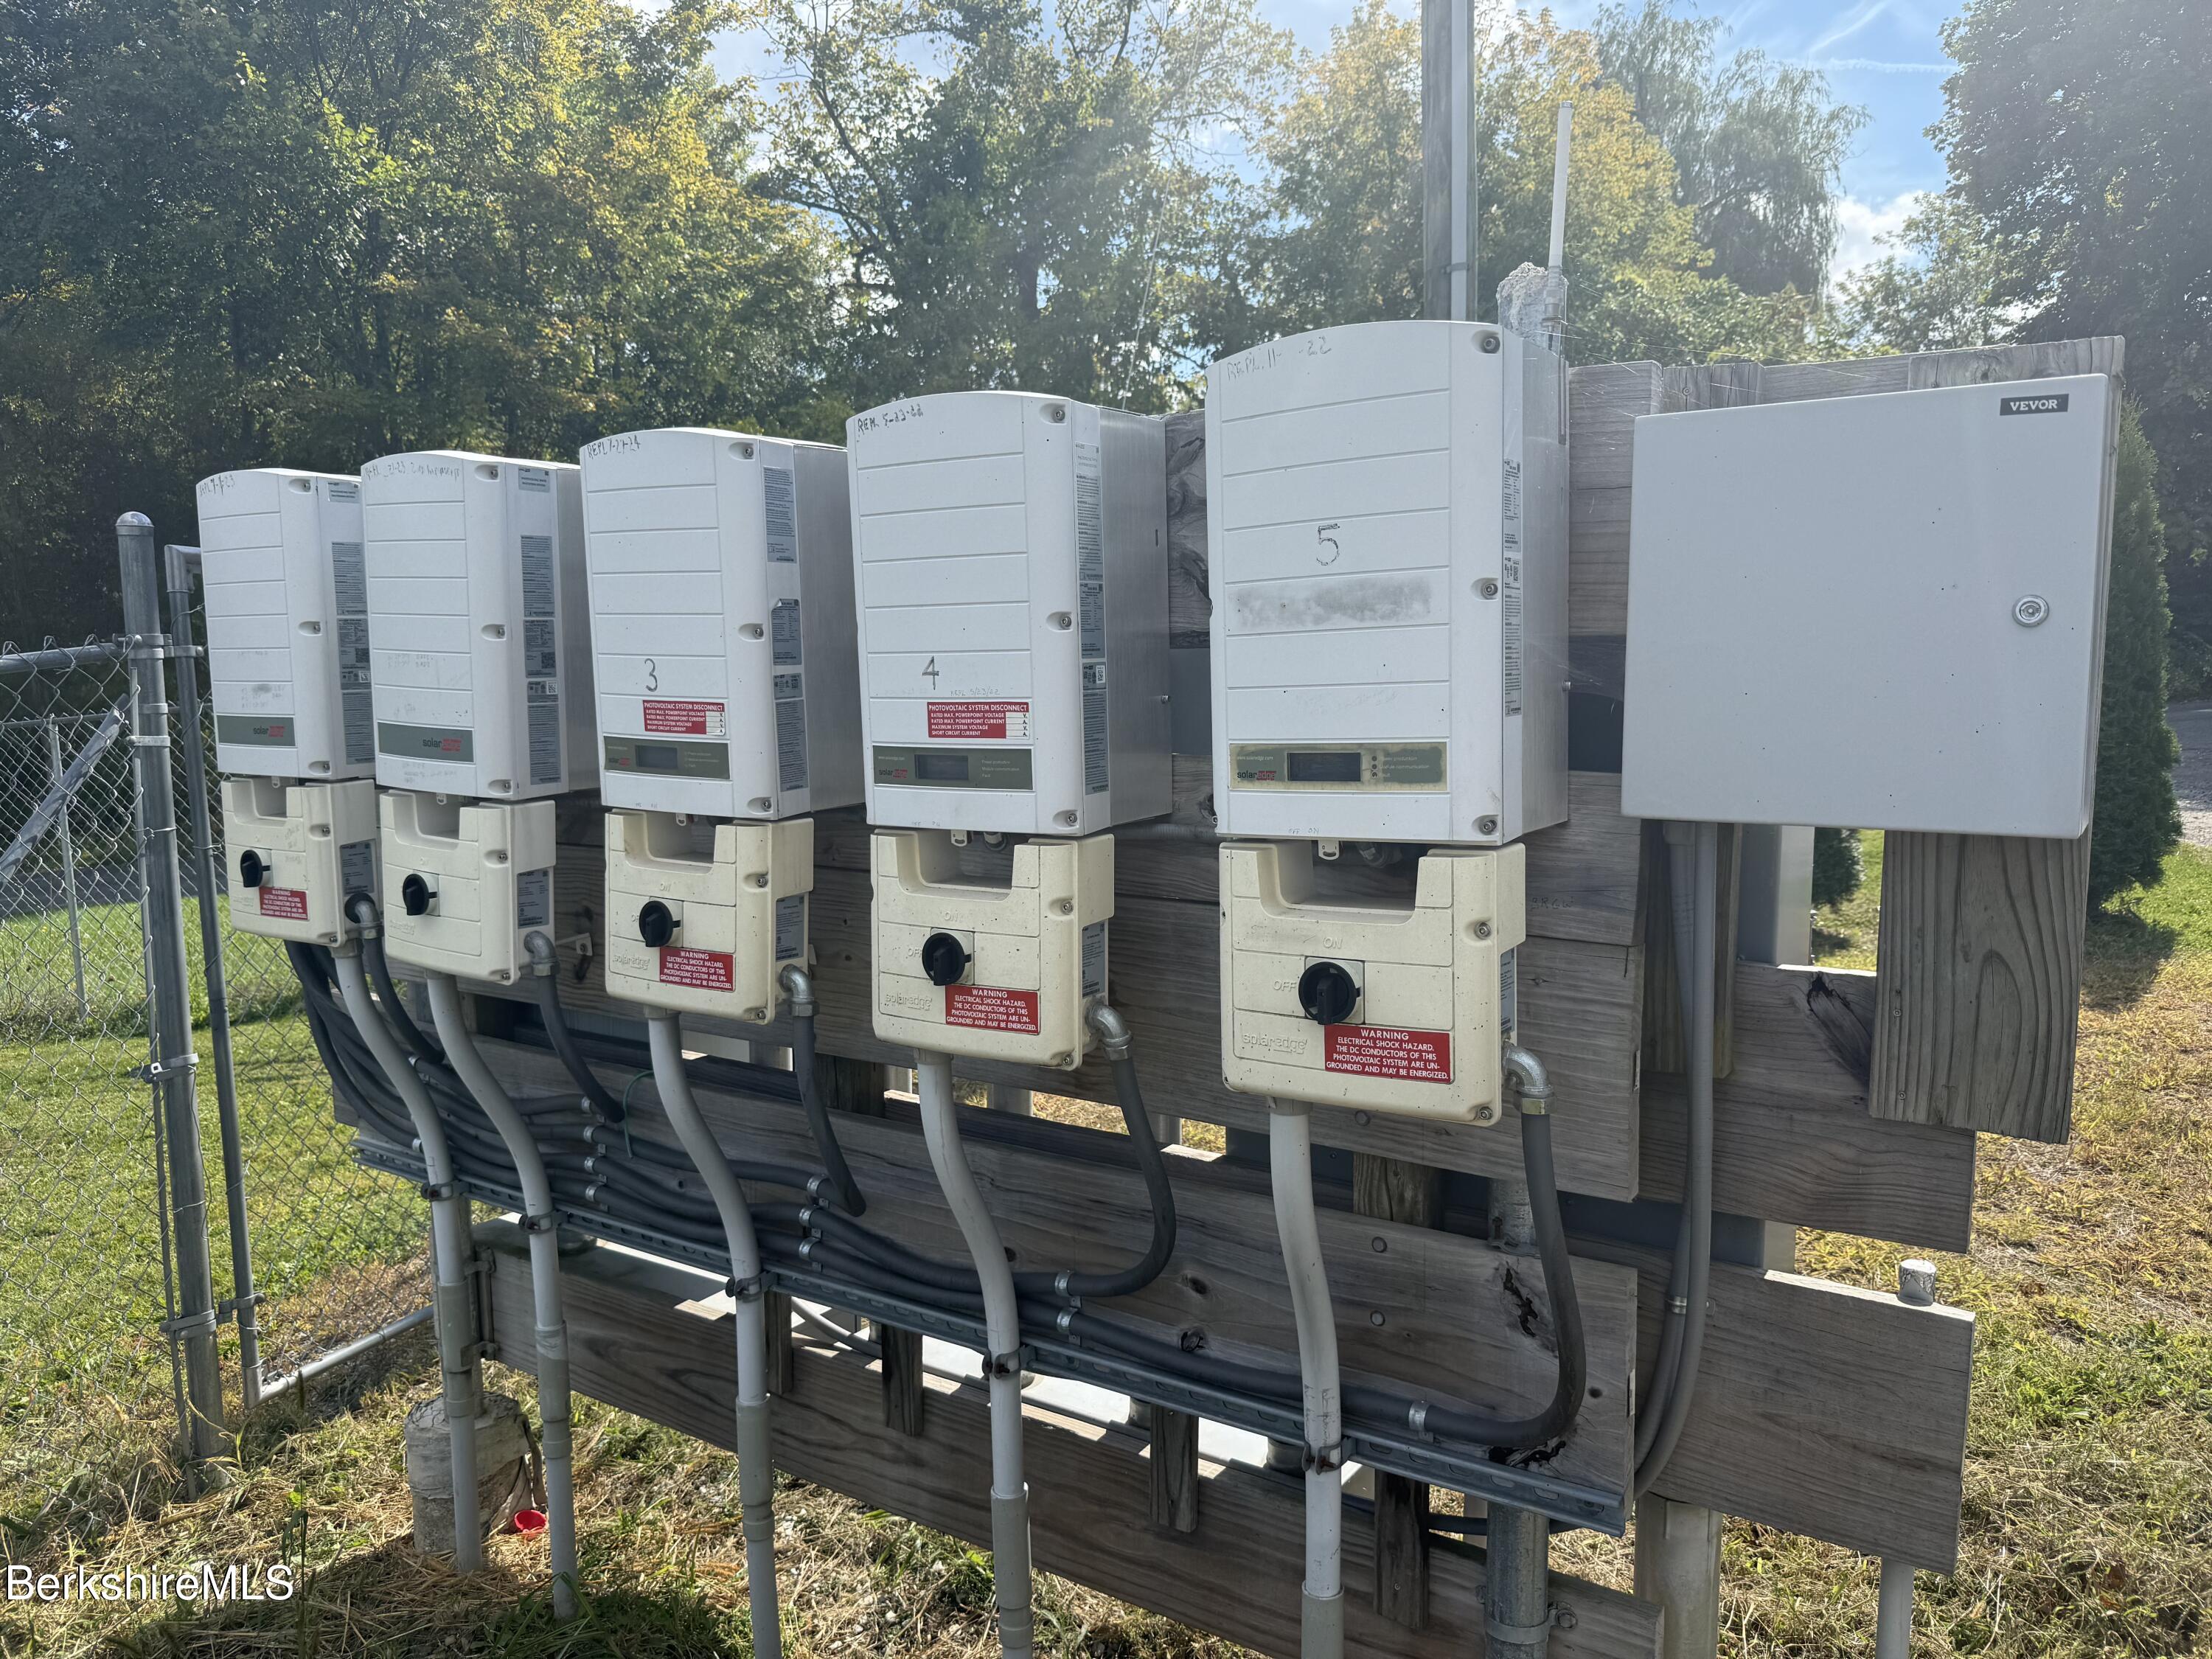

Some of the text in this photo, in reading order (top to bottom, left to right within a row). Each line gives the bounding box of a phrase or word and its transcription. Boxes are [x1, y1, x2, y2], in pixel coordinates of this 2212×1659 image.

[2010, 399, 2058, 411] VEVOR
[1316, 523, 1340, 566] 5
[644, 658, 658, 692] 3
[922, 655, 939, 691] 4
[1323, 936, 1343, 949] ON
[681, 951, 709, 959] WARNING
[1273, 979, 1297, 991] OFF
[955, 995, 982, 1003] ELECTRICAL
[972, 989, 1007, 998] WARNING
[952, 1009, 987, 1018] PHOTOVOLTAIC
[973, 1004, 1006, 1013] CONDUCTORS
[947, 1016, 973, 1024] GROUNDED
[1008, 1023, 1037, 1031] ENERGIZED.
[1361, 1029, 1409, 1040] WARNING
[1338, 1037, 1434, 1051] ELECTRICAL SHOCK HAZARD.
[1361, 1048, 1408, 1058] CONDUCTORS
[1333, 1054, 1381, 1065] PHOTOVOLTAIC
[1382, 1059, 1408, 1067] SYSTEM
[1326, 1062, 1363, 1071] GROUNDED
[1409, 1069, 1449, 1079] ENERGIZED.
